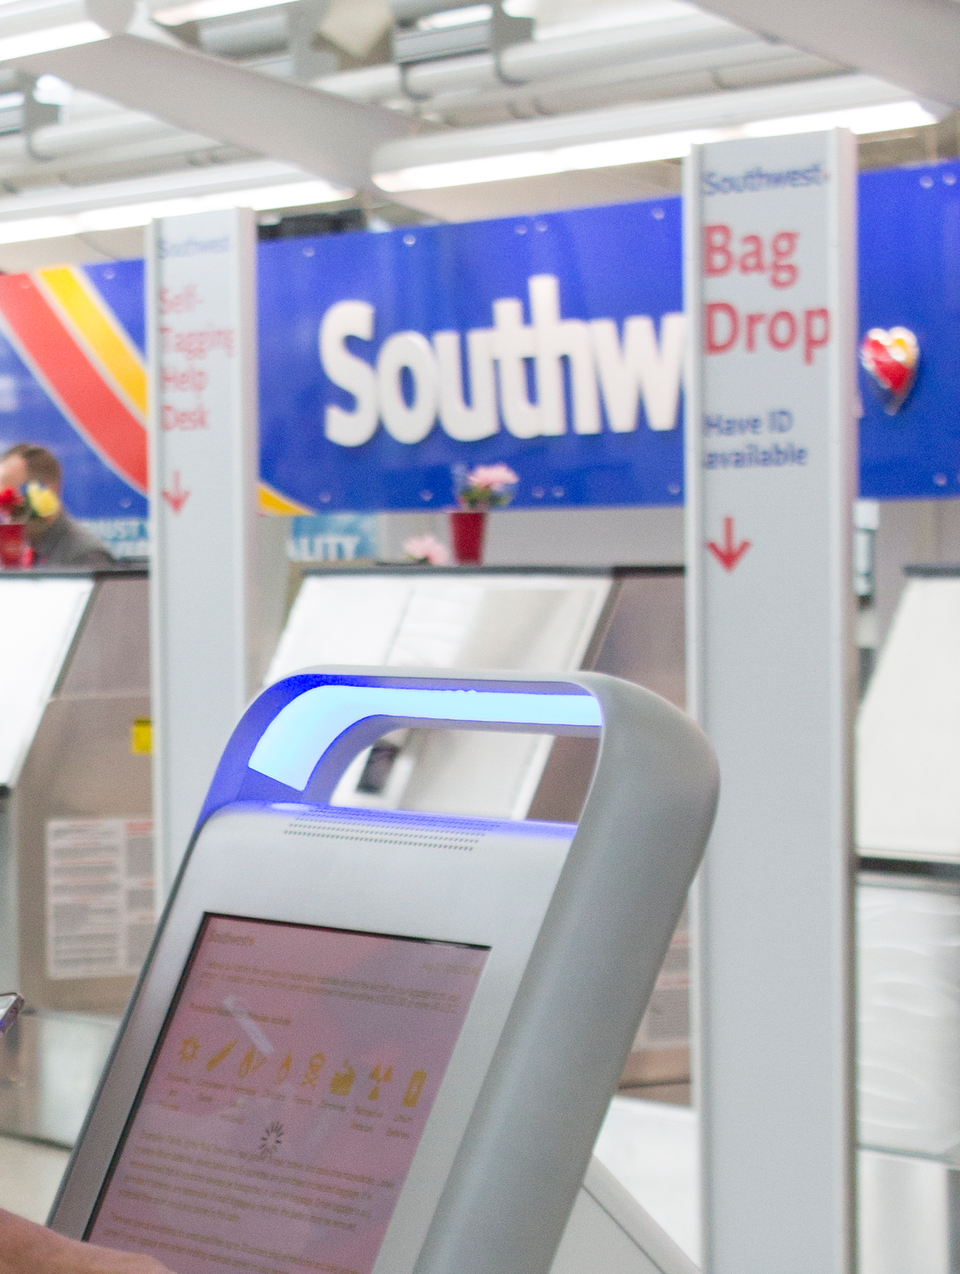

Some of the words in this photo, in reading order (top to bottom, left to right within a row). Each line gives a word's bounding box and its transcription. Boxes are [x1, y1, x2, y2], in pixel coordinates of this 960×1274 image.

[704, 224, 798, 290] Bag
[704, 303, 831, 364] Drop
[160, 366, 208, 397] Help
[160, 403, 208, 432] Desk
[705, 413, 762, 437] Have
[768, 409, 795, 434] ID
[704, 442, 808, 470] available
